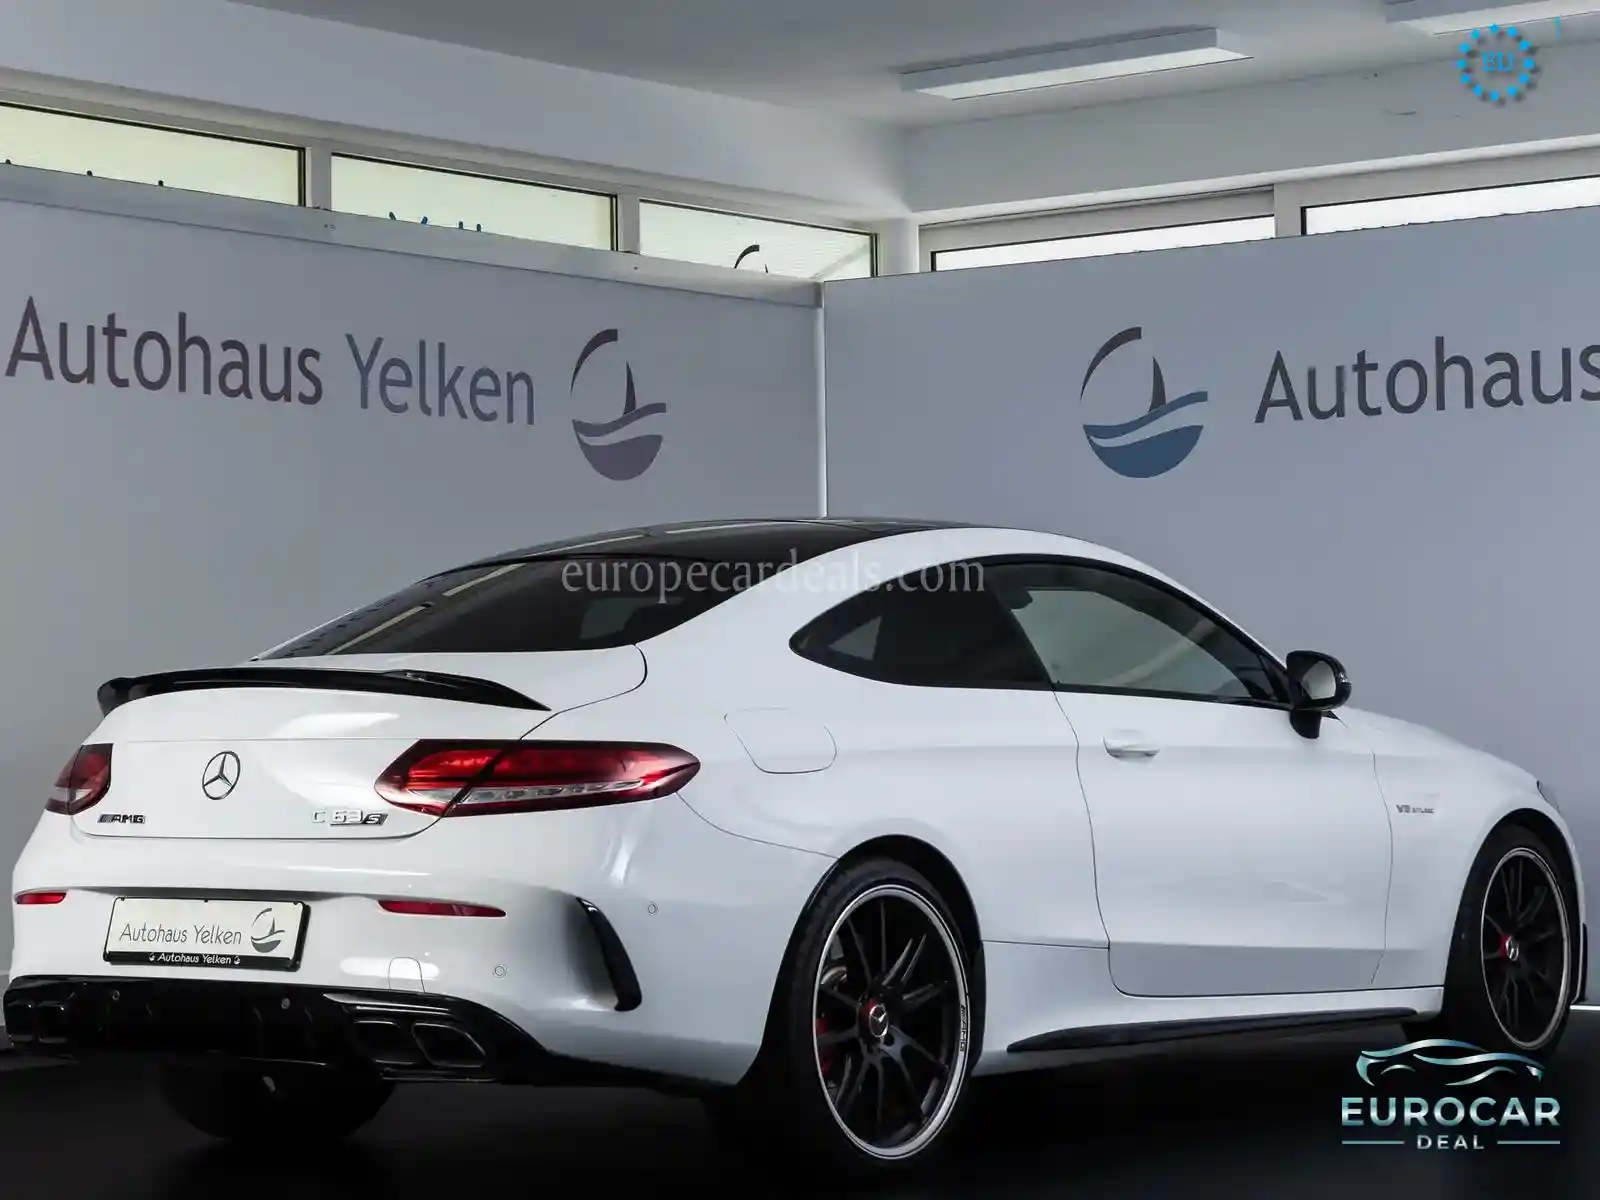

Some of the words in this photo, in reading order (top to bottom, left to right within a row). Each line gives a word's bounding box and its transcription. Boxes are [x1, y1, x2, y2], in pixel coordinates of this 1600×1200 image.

[5, 296, 323, 406] Autohaus
[345, 332, 535, 426] Yelken
[1254, 336, 1600, 424] Autohaus
[110, 814, 146, 824] AMG
[119, 922, 188, 944] Autohaus
[193, 924, 242, 946] Yelken
[157, 953, 200, 964] Autohaus
[202, 955, 232, 965] Yelken
